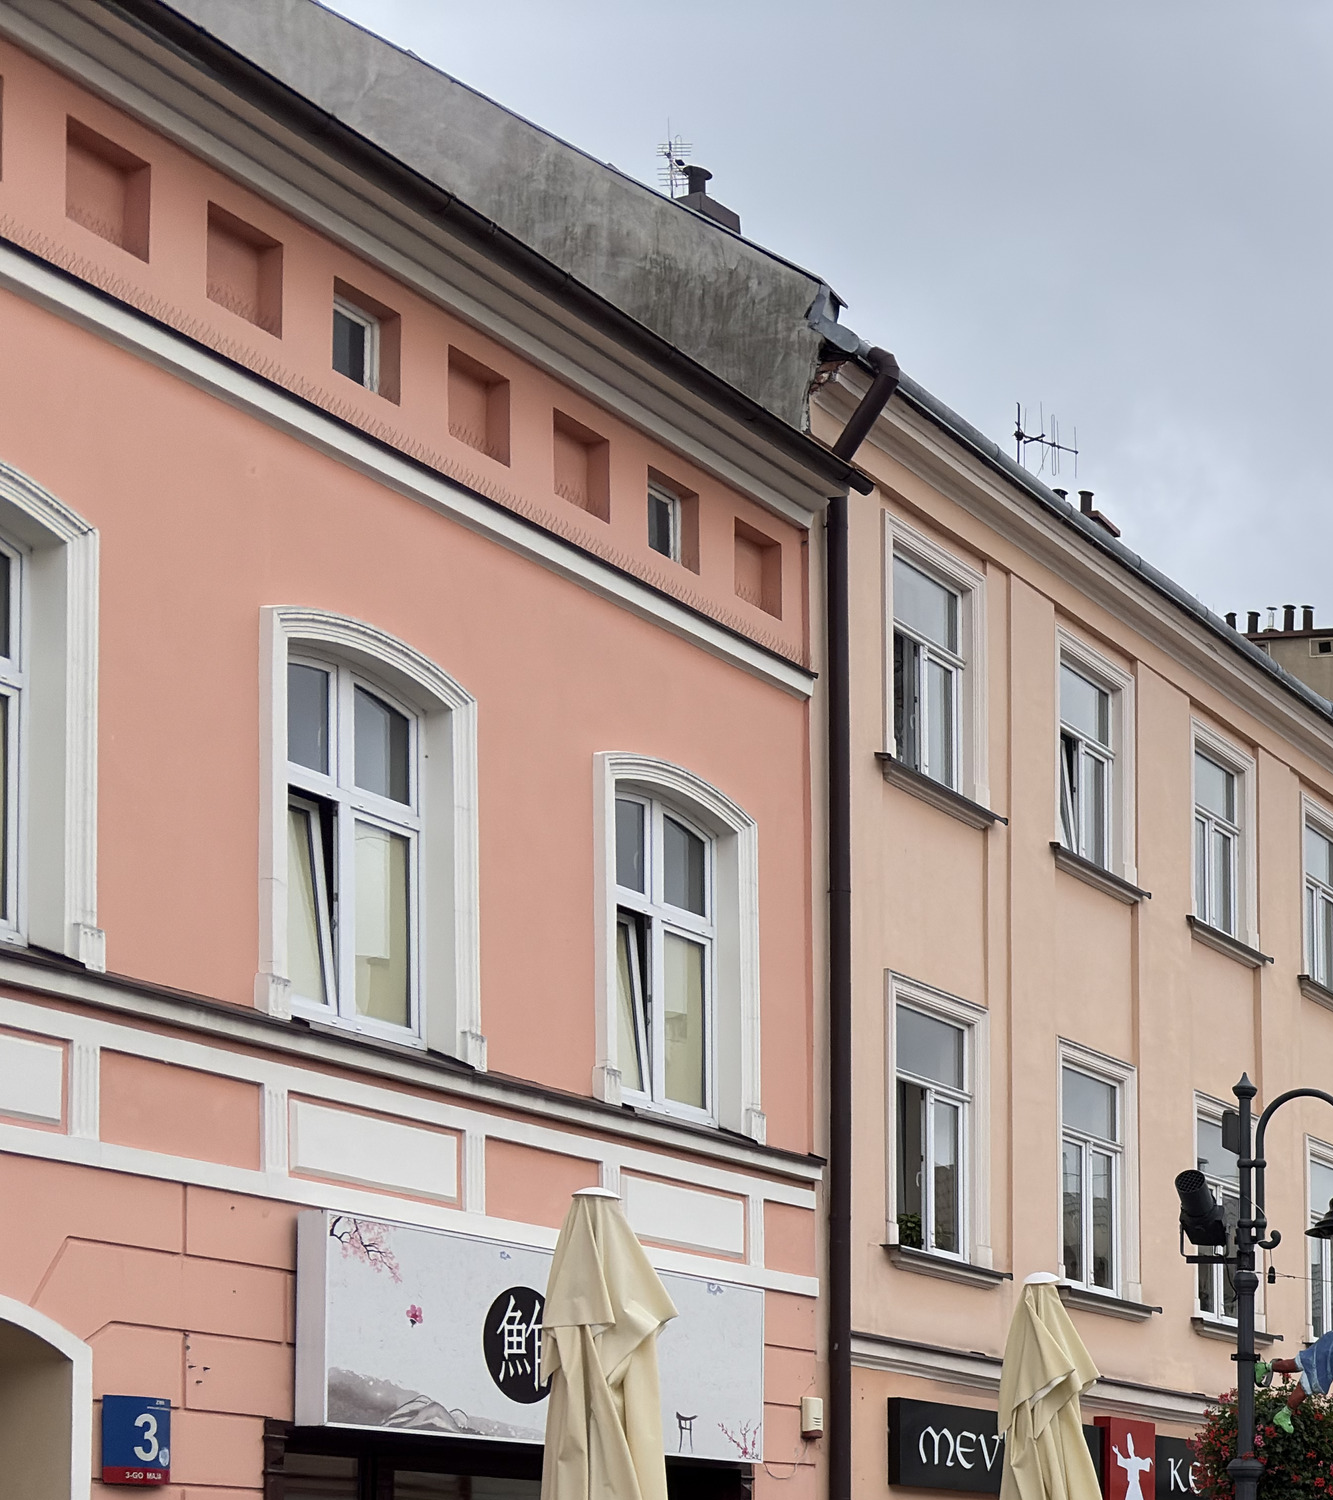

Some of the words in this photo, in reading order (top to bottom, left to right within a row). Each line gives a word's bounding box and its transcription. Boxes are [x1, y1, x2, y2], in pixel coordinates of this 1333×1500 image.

[133, 1413, 159, 1462] 3
[919, 1426, 1005, 1472] MEV
[125, 1471, 144, 1479] 3-GO
[146, 1472, 162, 1480] MAJA
